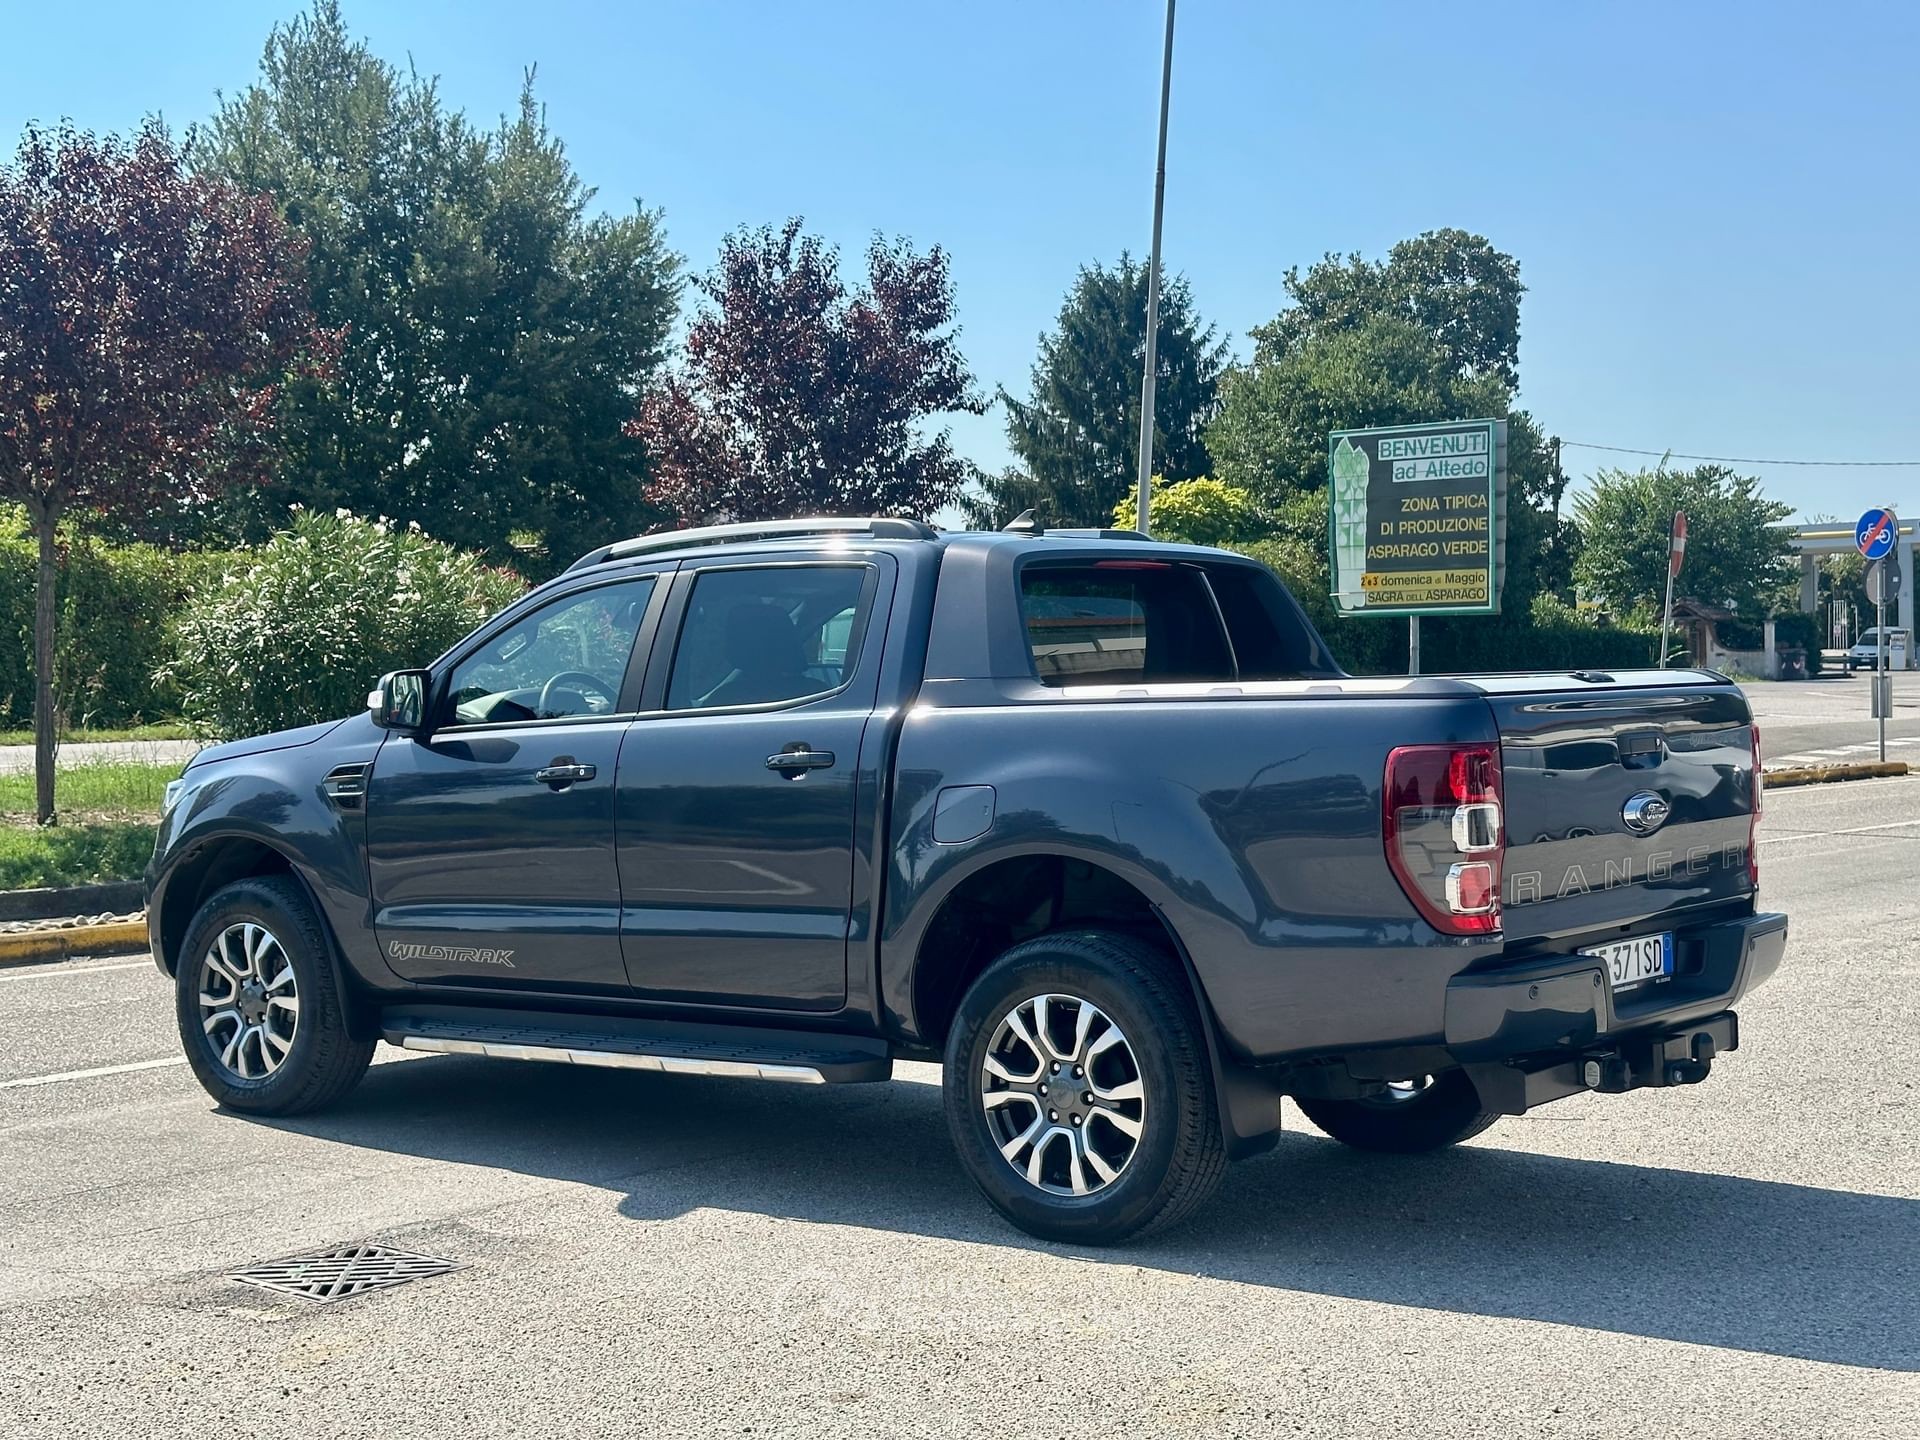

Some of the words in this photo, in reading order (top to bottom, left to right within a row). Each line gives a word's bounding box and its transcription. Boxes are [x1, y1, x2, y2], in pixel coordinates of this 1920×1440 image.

[1380, 433, 1486, 458] BENVENUTI
[1395, 464, 1416, 480] ad
[1425, 460, 1485, 478] Altedo
[1401, 498, 1440, 512] ZONA
[1444, 494, 1487, 510] TIPICA
[1380, 522, 1394, 536] DI
[1399, 517, 1488, 534] PRODUZIONE
[1368, 542, 1439, 559] ASPARAGO
[1442, 540, 1488, 555] VERDE
[1380, 574, 1432, 586] domenica
[1444, 572, 1485, 585] Maggio
[1368, 591, 1404, 602] SAGRA
[1426, 588, 1485, 600] ASPARAGO
[1510, 838, 1744, 906] RANGER
[388, 940, 516, 968] WILDTRAK
